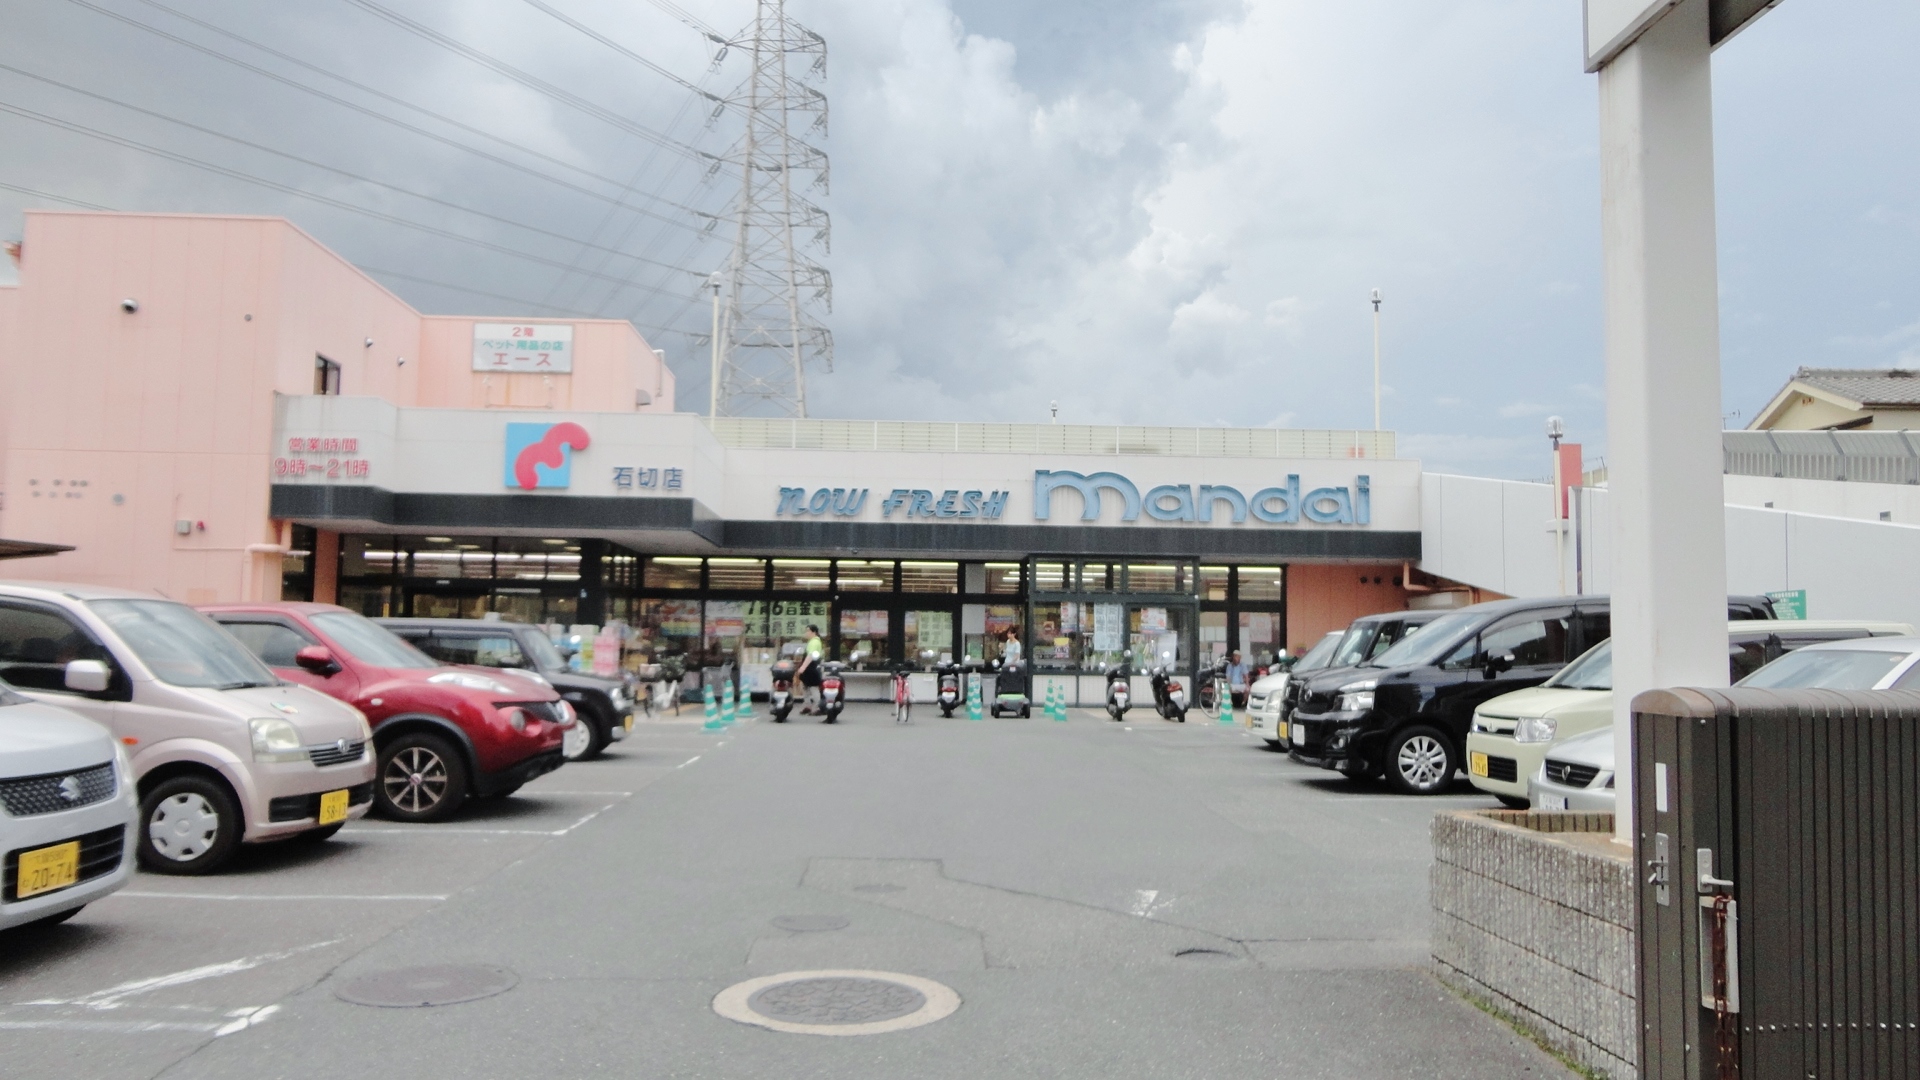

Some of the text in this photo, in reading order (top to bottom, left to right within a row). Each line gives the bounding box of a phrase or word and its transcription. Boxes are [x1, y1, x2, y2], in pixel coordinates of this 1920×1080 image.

[493, 352, 551, 366] エース
[288, 437, 358, 453] 営業時間
[612, 466, 683, 489] 石切店
[882, 488, 1009, 519] FRESH
[1034, 469, 1370, 524] mandai
